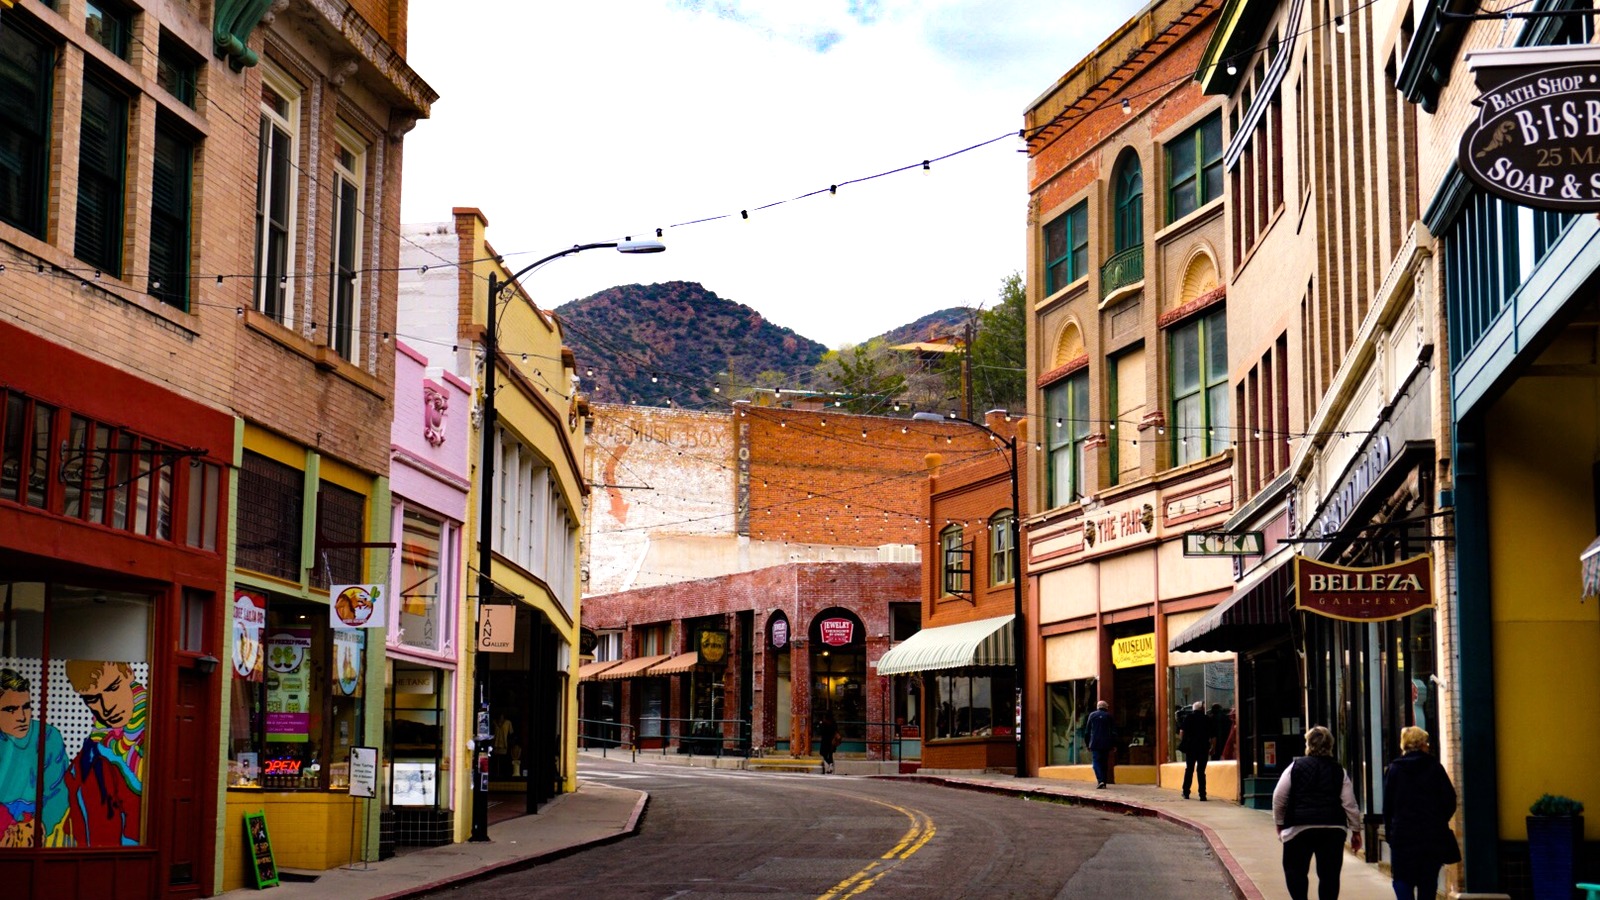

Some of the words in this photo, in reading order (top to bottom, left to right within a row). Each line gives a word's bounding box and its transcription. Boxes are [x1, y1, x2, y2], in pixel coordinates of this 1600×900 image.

[1490, 84, 1536, 112] BATH
[1537, 75, 1583, 95] SHOP
[1537, 148, 1562, 167] 25
[1487, 157, 1554, 196] SOAP
[1561, 173, 1582, 198] &
[680, 423, 729, 449] BOX
[1097, 515, 1116, 543] THE
[1120, 507, 1142, 538] FAIR
[1187, 534, 1259, 553] ROKA
[1309, 573, 1424, 592] BELLEZA
[1319, 597, 1411, 605] GALLERY
[824, 621, 850, 631] JEWELRY
[1118, 637, 1153, 655] MUSEUM
[265, 760, 301, 772] OPEN
